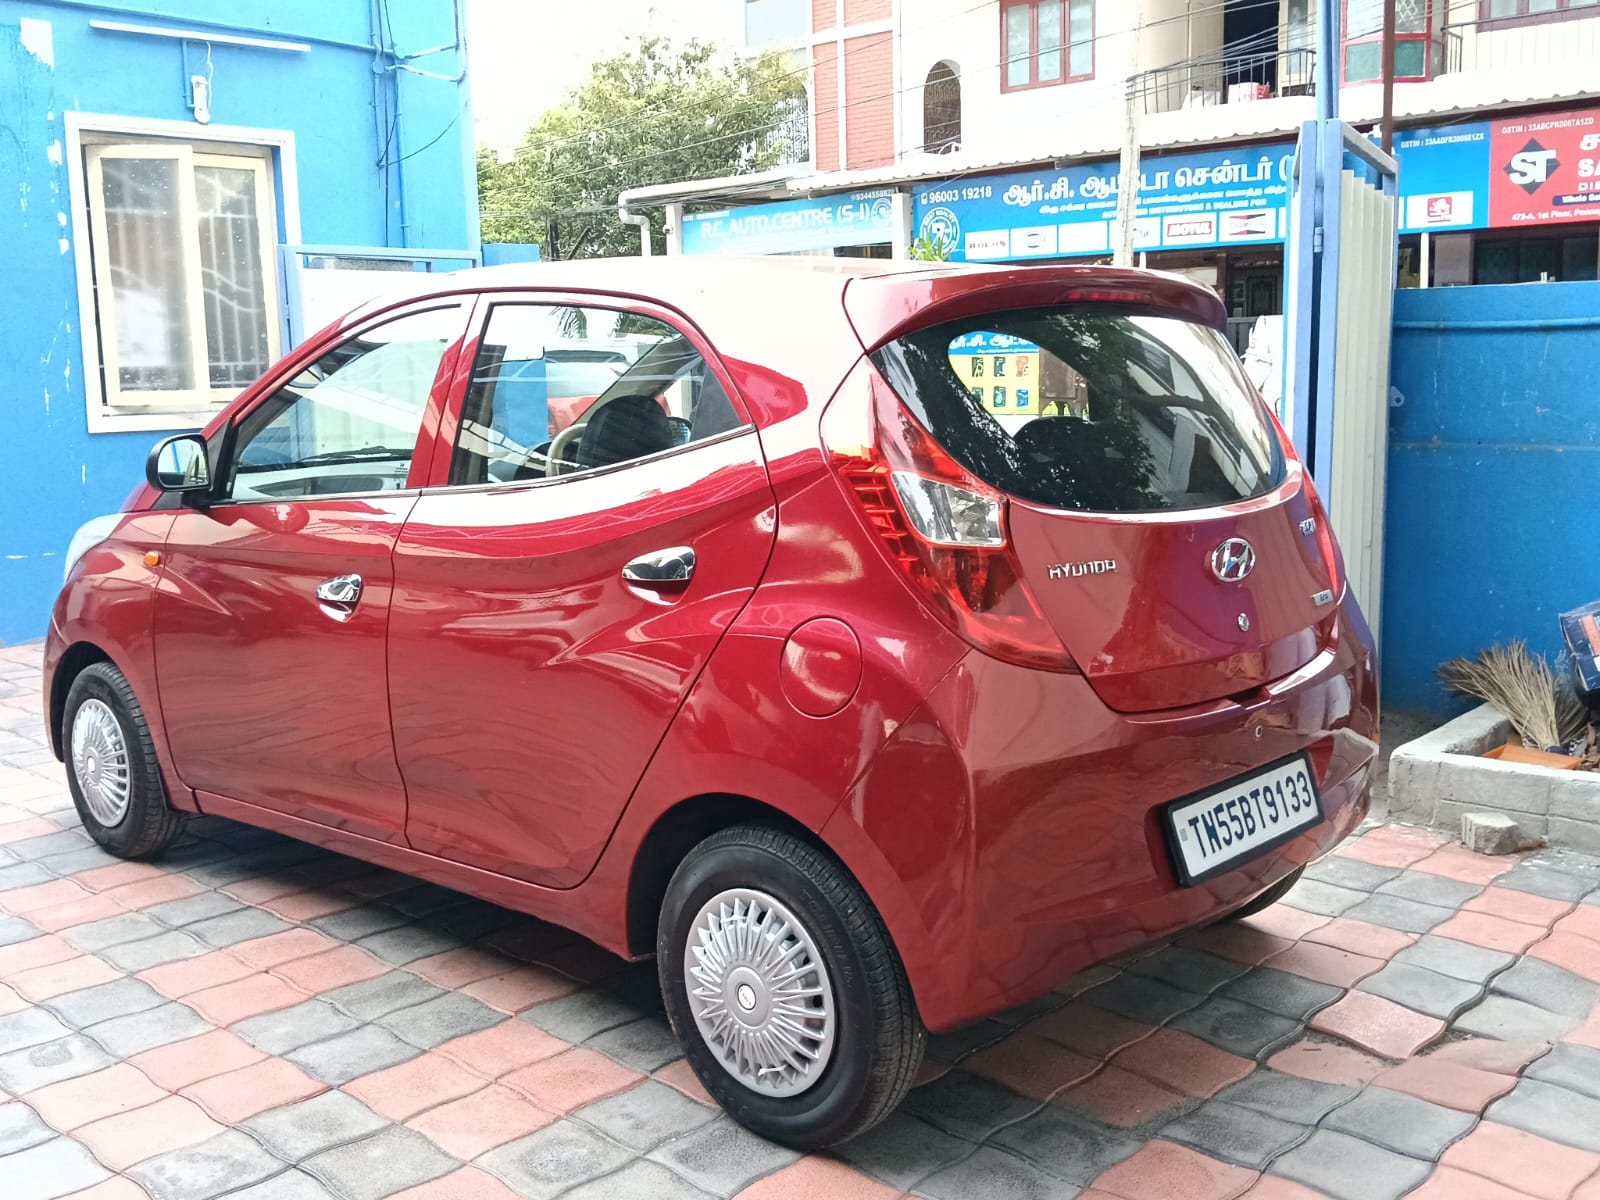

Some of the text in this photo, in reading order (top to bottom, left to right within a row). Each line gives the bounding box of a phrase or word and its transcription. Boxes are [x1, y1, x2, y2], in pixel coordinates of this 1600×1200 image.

[1175, 156, 1274, 186] சென்டர்
[1509, 150, 1556, 184] ST
[929, 185, 992, 204] 96003 19218
[1188, 771, 1312, 858] TN55BT9133
